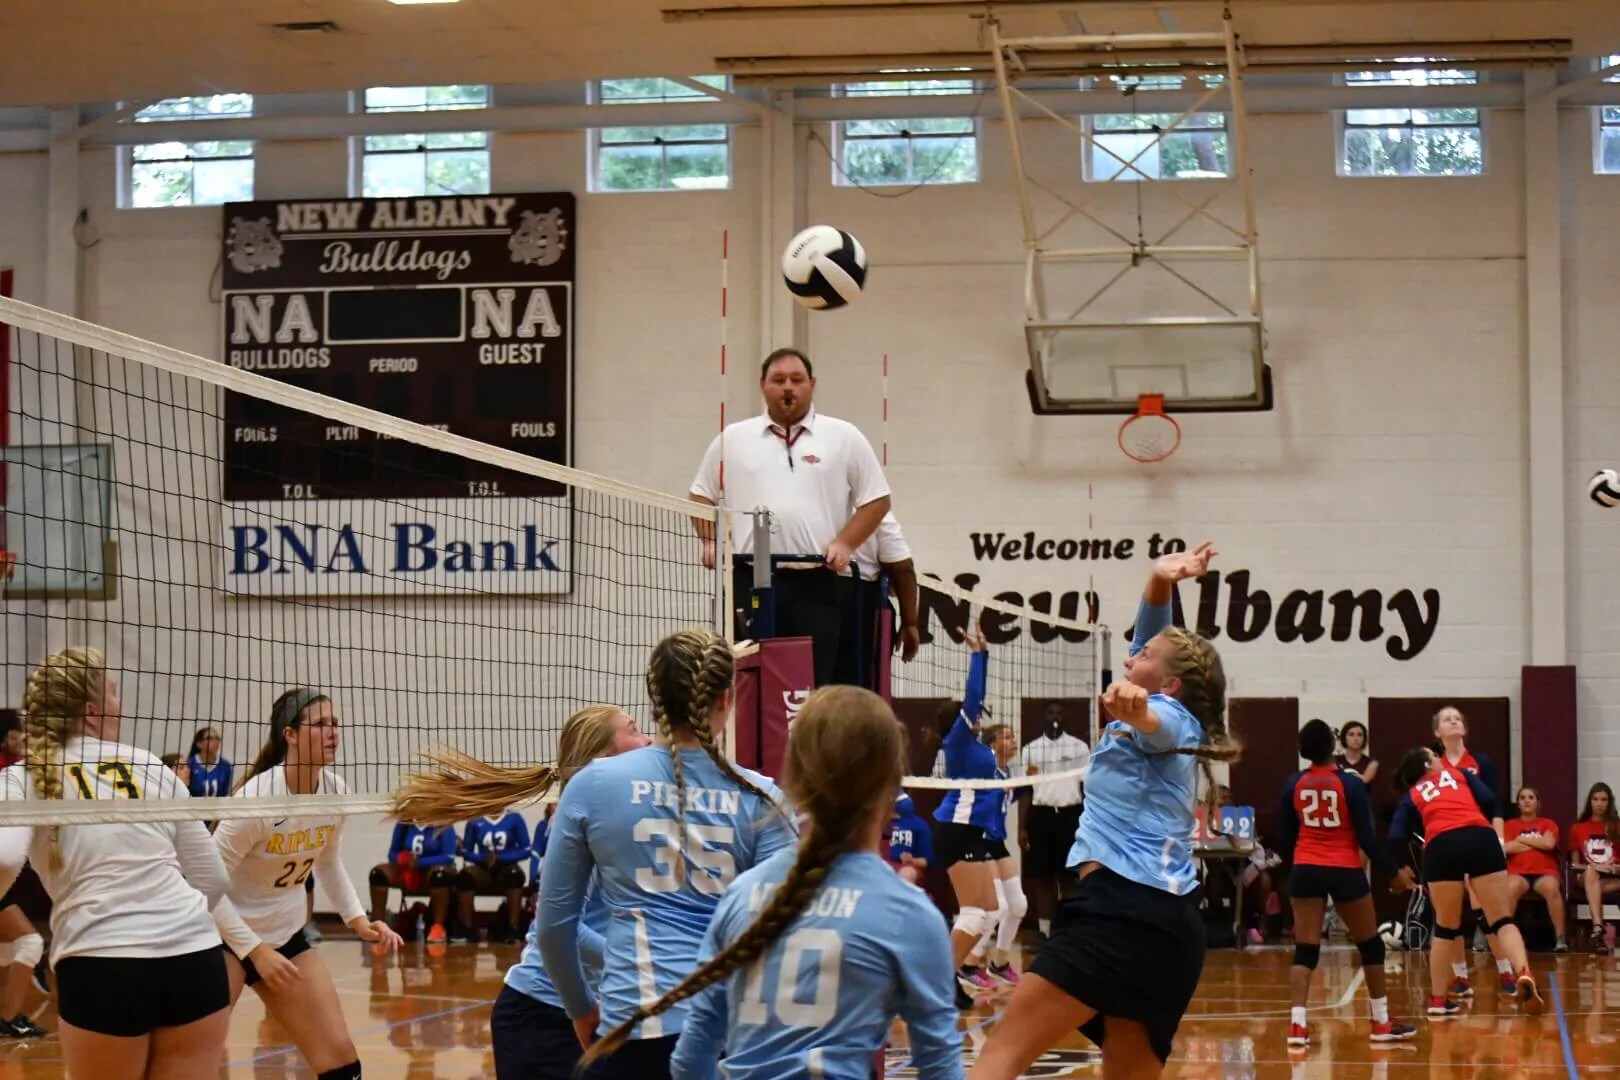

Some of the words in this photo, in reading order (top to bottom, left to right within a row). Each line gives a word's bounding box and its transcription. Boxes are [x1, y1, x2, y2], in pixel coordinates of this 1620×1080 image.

[276, 201, 363, 231] NEW
[371, 198, 516, 228] ALBANY
[319, 240, 472, 280] Bulldogs
[231, 295, 318, 344] NA
[471, 288, 562, 338] NA
[230, 348, 331, 369] BULLDOGS
[369, 358, 418, 373] PERIOD
[479, 344, 546, 365] GUEST
[233, 426, 279, 442] FOULS
[511, 422, 556, 438] FOULS
[228, 523, 369, 574] BNA
[389, 523, 560, 573] Bank
[970, 531, 1135, 560] Welcome
[1148, 533, 1187, 559] to
[914, 573, 1099, 644] New
[1415, 769, 1458, 802] 24
[1300, 789, 1341, 827] 23
[265, 824, 335, 855] RIPLEY
[411, 835, 425, 855] 6
[633, 818, 735, 894] 35
[274, 858, 314, 888] 22
[738, 928, 842, 1029] 10
